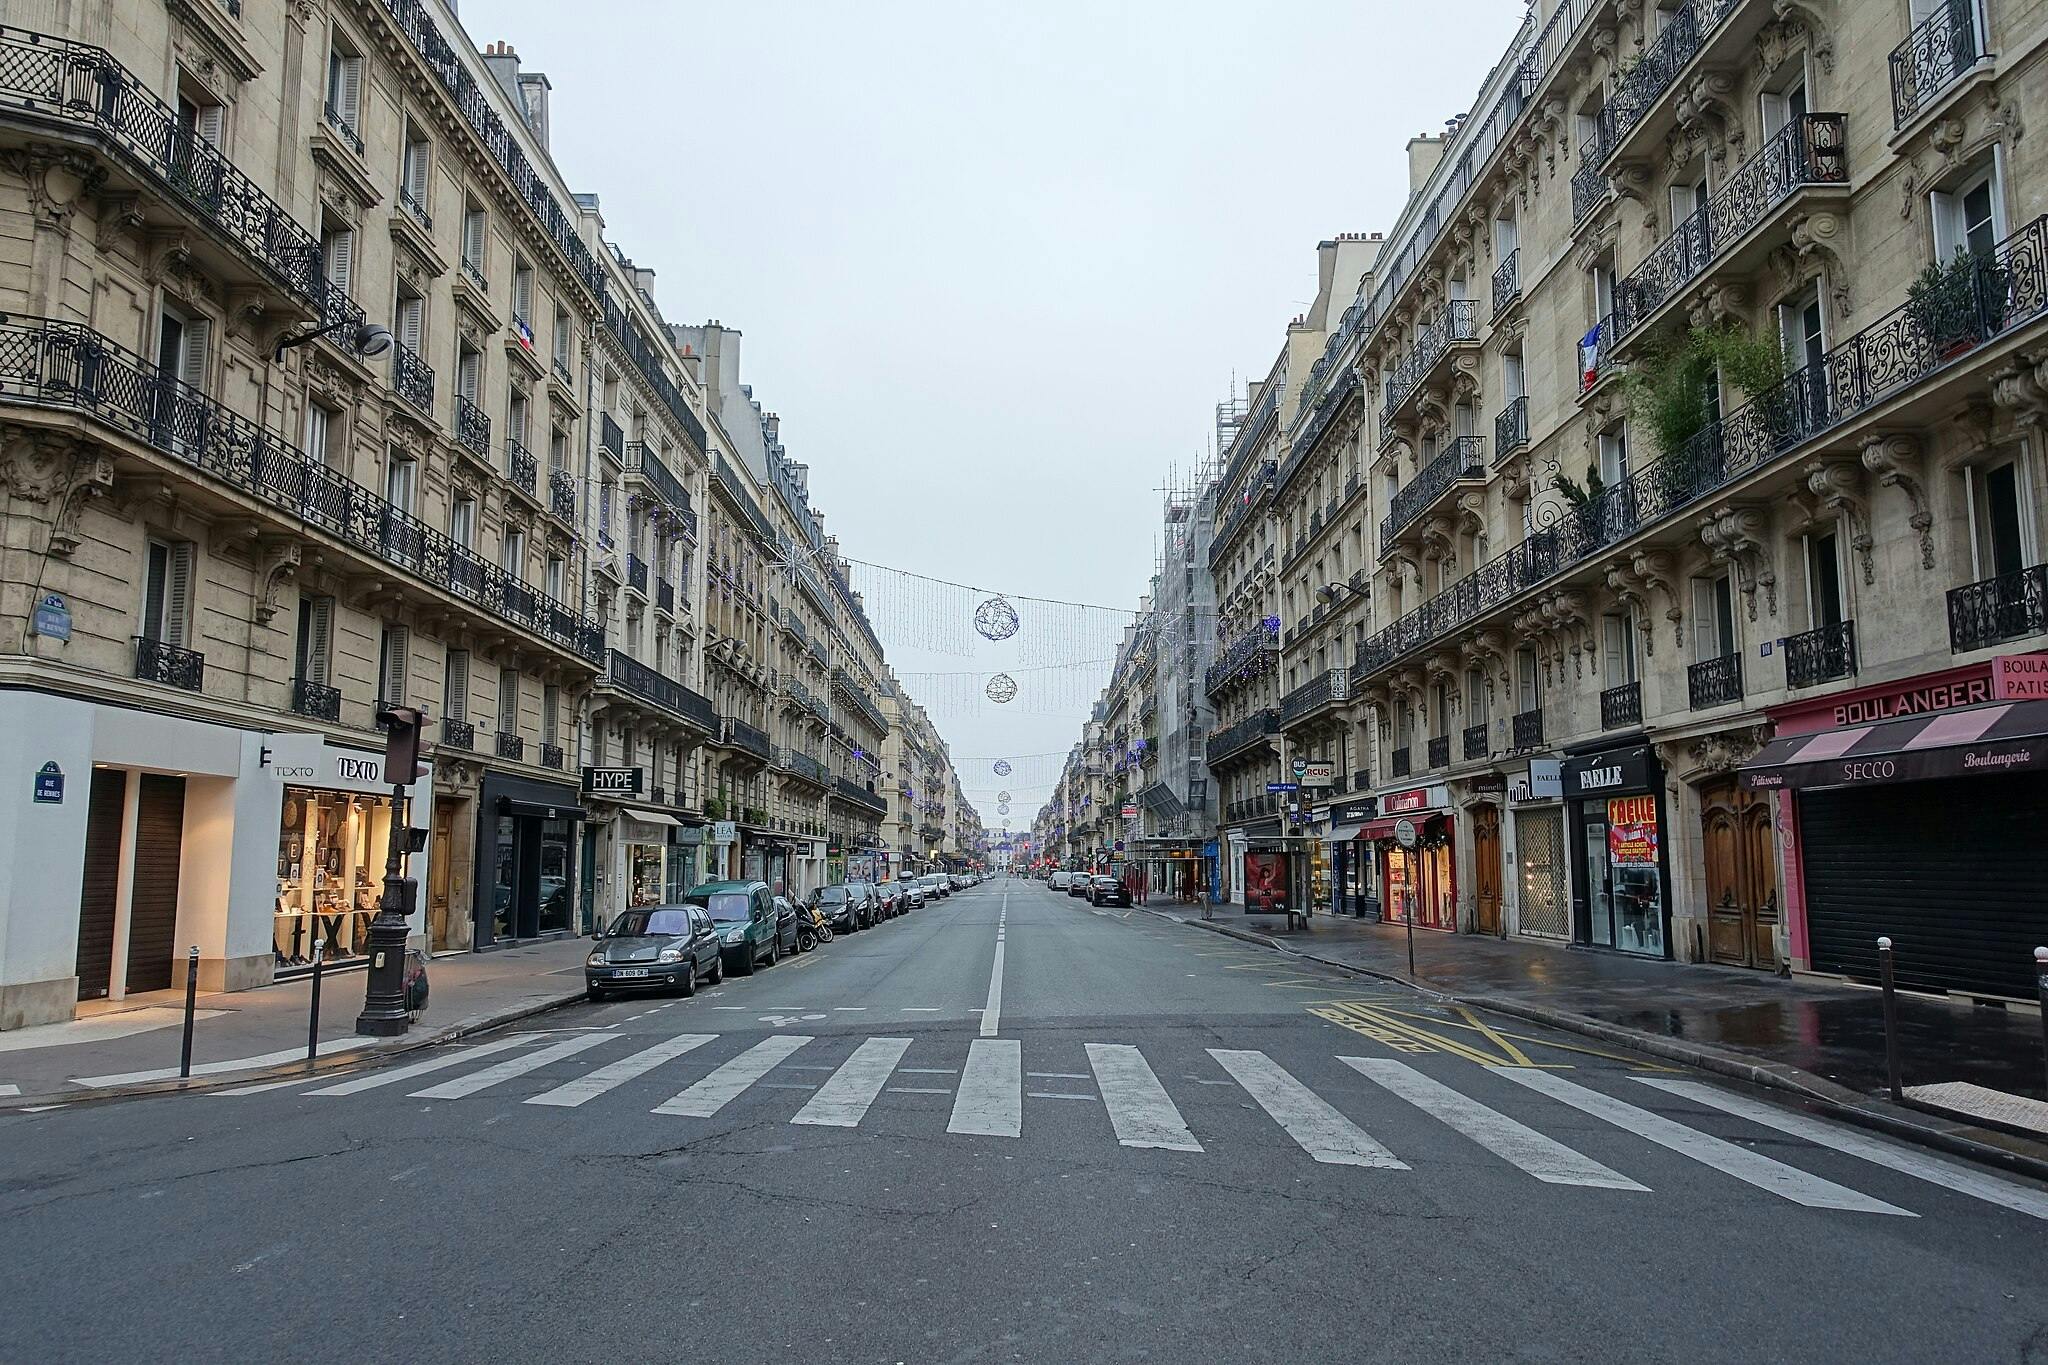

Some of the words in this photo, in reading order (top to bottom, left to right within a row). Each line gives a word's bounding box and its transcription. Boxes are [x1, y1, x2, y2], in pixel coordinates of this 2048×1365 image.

[1293, 760, 1306, 768] BUS
[1964, 749, 2031, 769] Boulangerie
[274, 766, 314, 777] TEXTO
[337, 757, 379, 781] TEXTO
[1844, 760, 1895, 781] SECCO
[45, 779, 55, 787] RUE
[592, 772, 633, 788] HYPE
[1580, 765, 1623, 790] FAELLE
[1751, 774, 1783, 787] Pâtisserie
[1478, 781, 1504, 791] minelli
[44, 790, 60, 798] RENNES
[716, 824, 733, 835] LÉA
